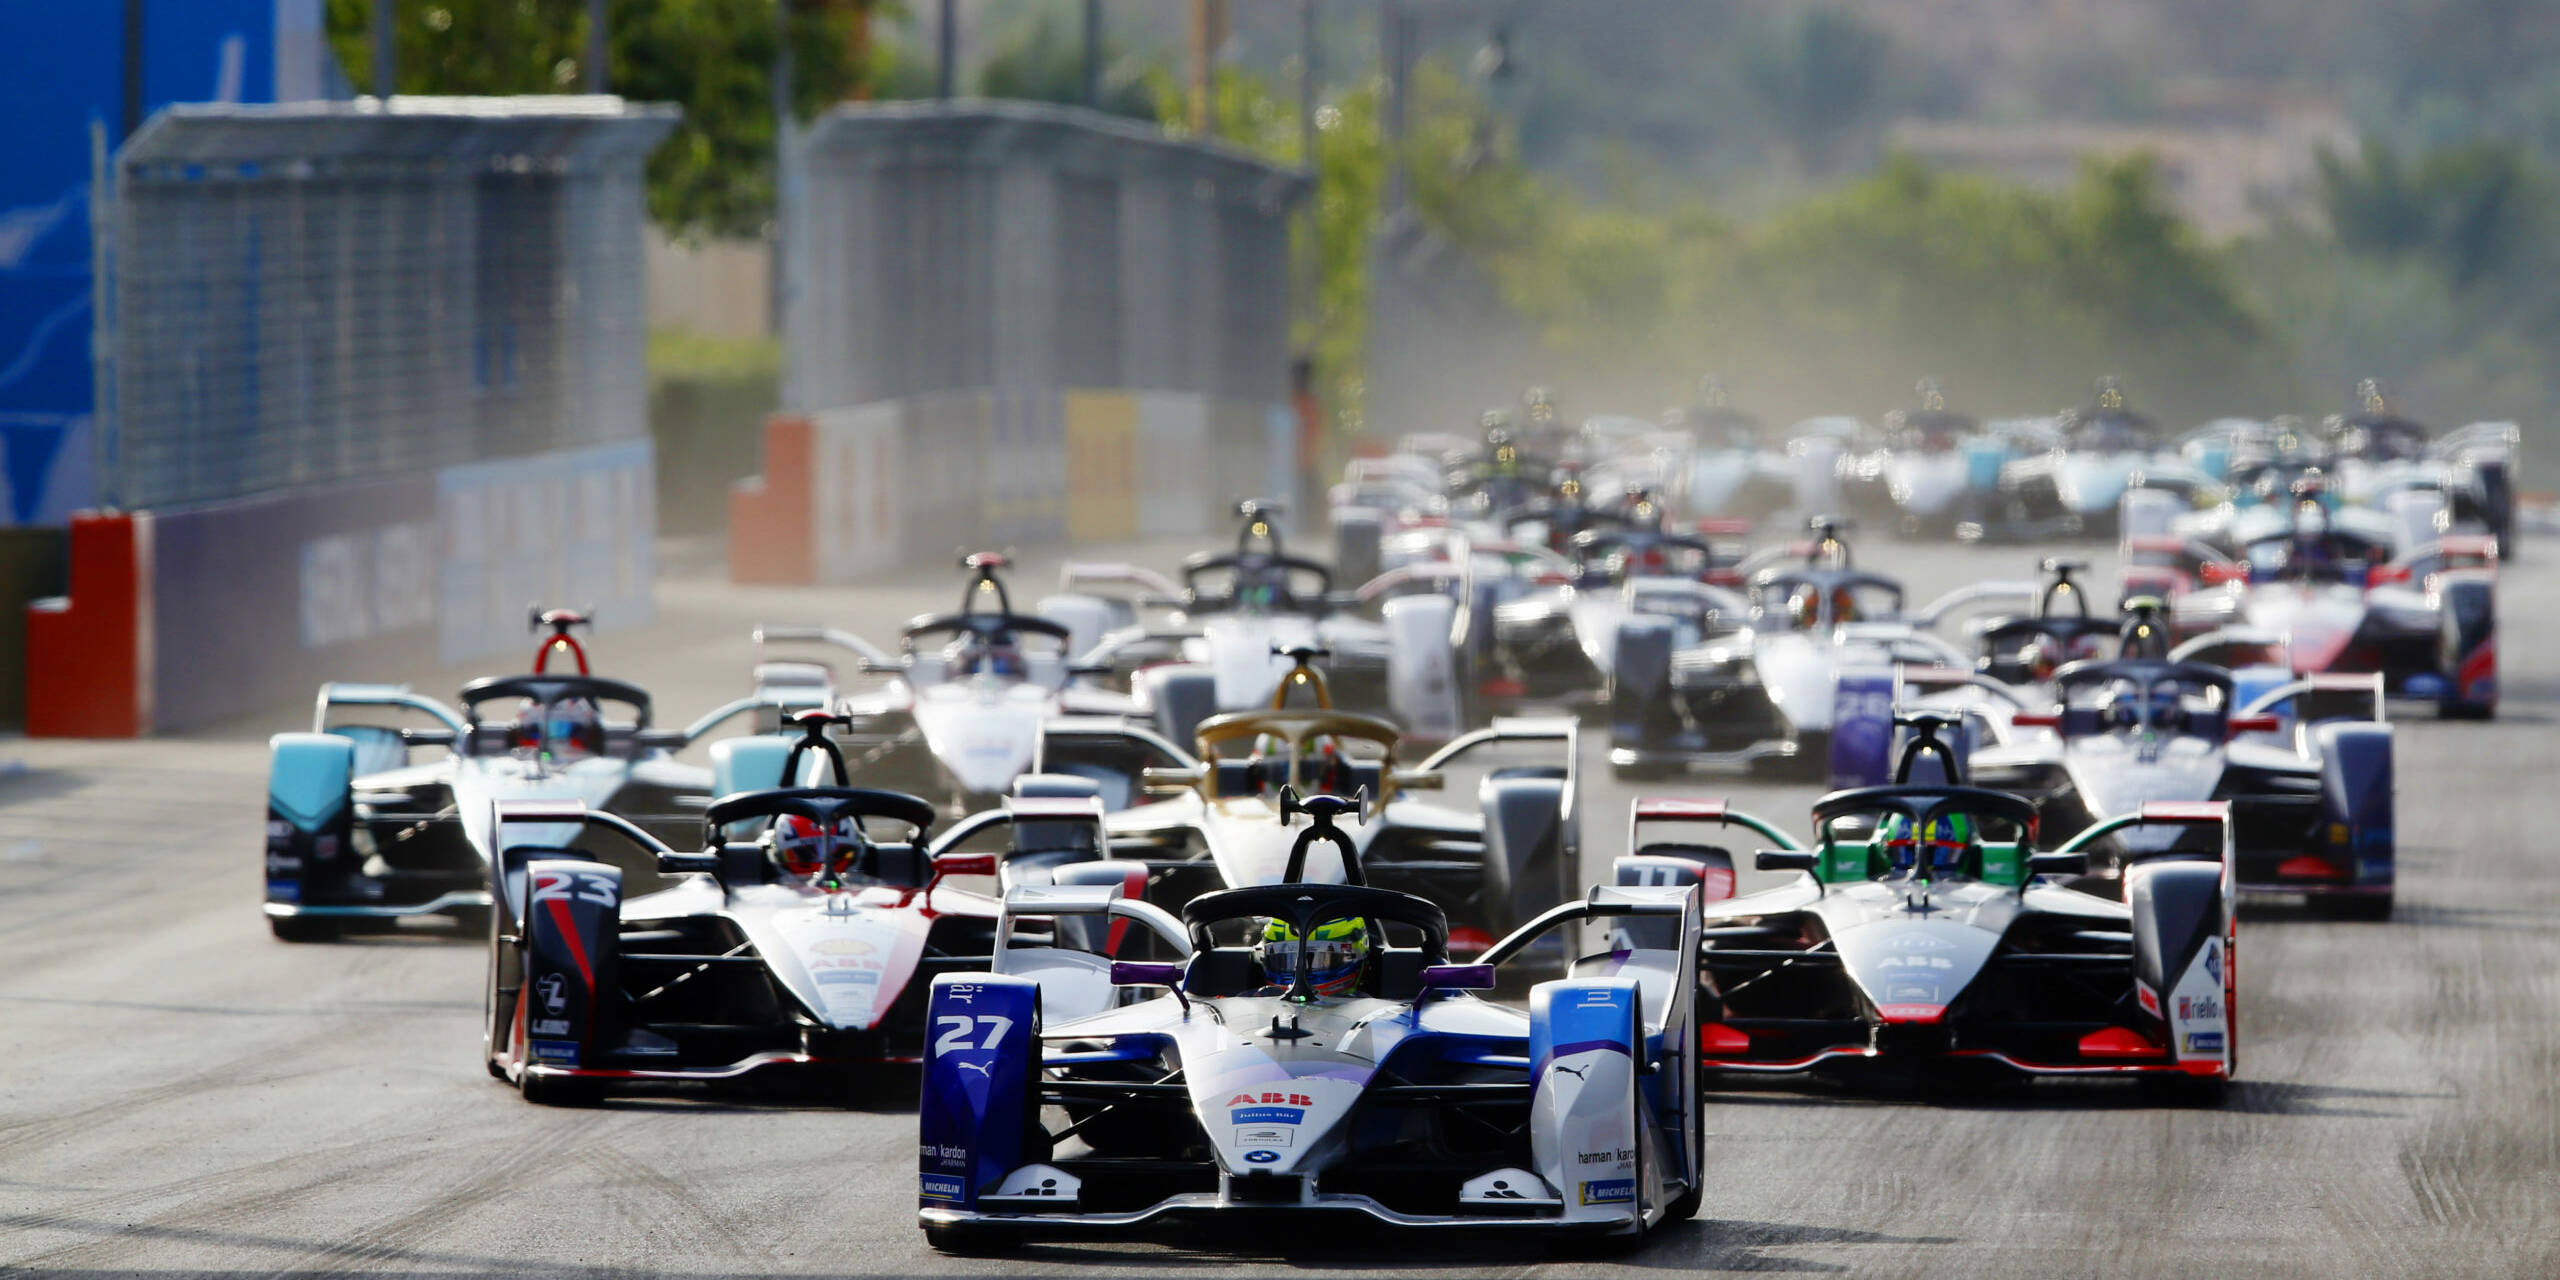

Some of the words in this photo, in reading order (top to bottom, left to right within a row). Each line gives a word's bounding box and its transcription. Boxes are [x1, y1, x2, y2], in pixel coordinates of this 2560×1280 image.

[533, 871, 618, 908] 23
[935, 1015, 1014, 1059] 27
[1225, 1092, 1313, 1107] ABB
[1578, 1151, 1612, 1164] harman
[925, 1182, 961, 1193] MICHELIN
